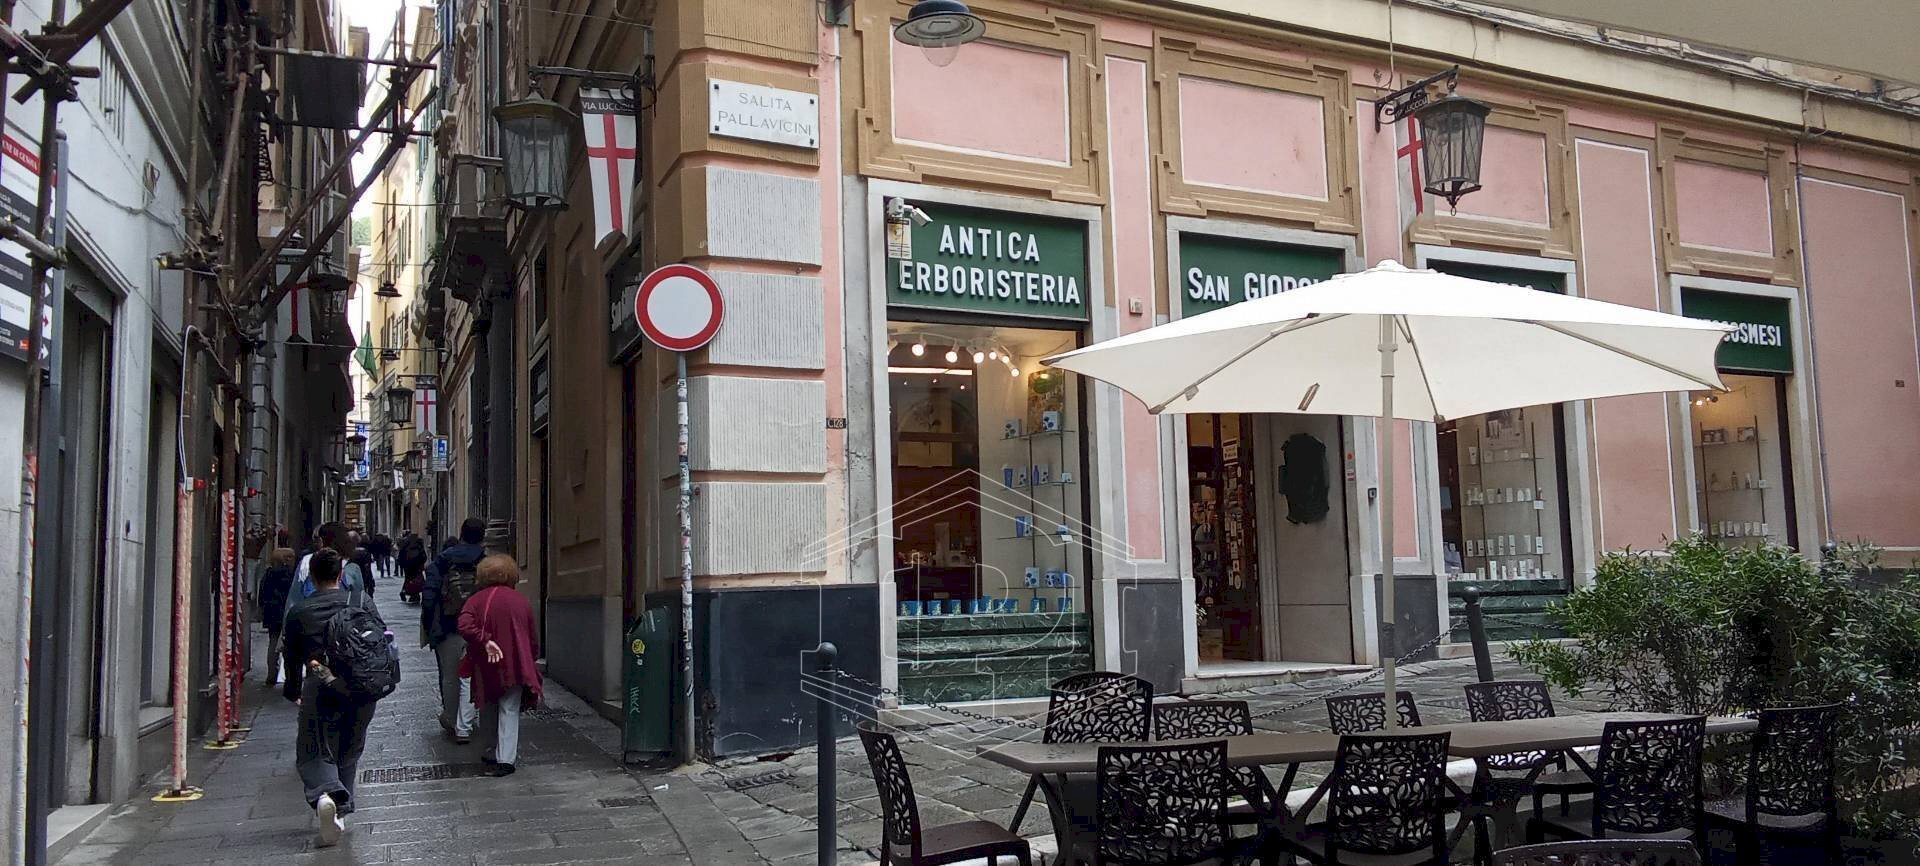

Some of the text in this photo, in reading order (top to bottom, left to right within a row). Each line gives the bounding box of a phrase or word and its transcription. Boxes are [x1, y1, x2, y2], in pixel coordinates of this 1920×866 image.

[581, 101, 597, 110] VIA
[738, 92, 792, 112] SALITA
[717, 110, 812, 136] PALLAVICINI
[938, 224, 1041, 264] ANTICA
[898, 260, 1082, 306] ERBORISTERIA
[1187, 267, 1320, 303] SAN GIOR
